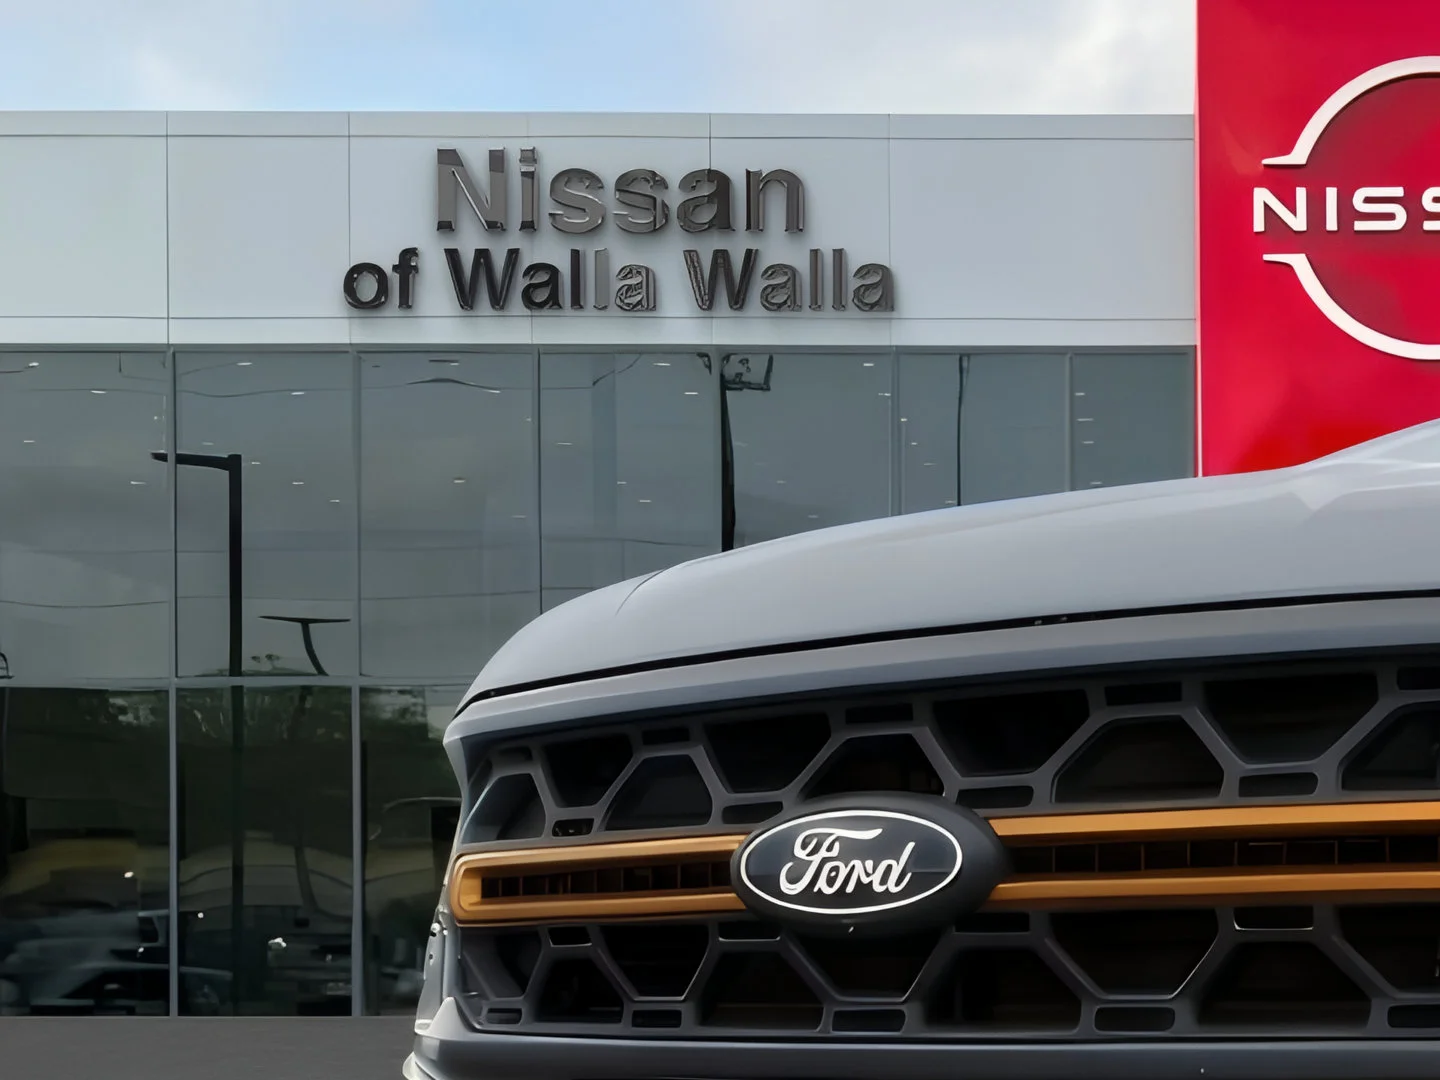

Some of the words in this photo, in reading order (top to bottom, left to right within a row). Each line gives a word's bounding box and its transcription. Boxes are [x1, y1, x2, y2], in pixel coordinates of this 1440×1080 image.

[435, 145, 806, 233] Nissan
[343, 246, 420, 310] of
[444, 247, 657, 312] Walla
[682, 247, 896, 312] Walla
[779, 827, 916, 895] Ford
